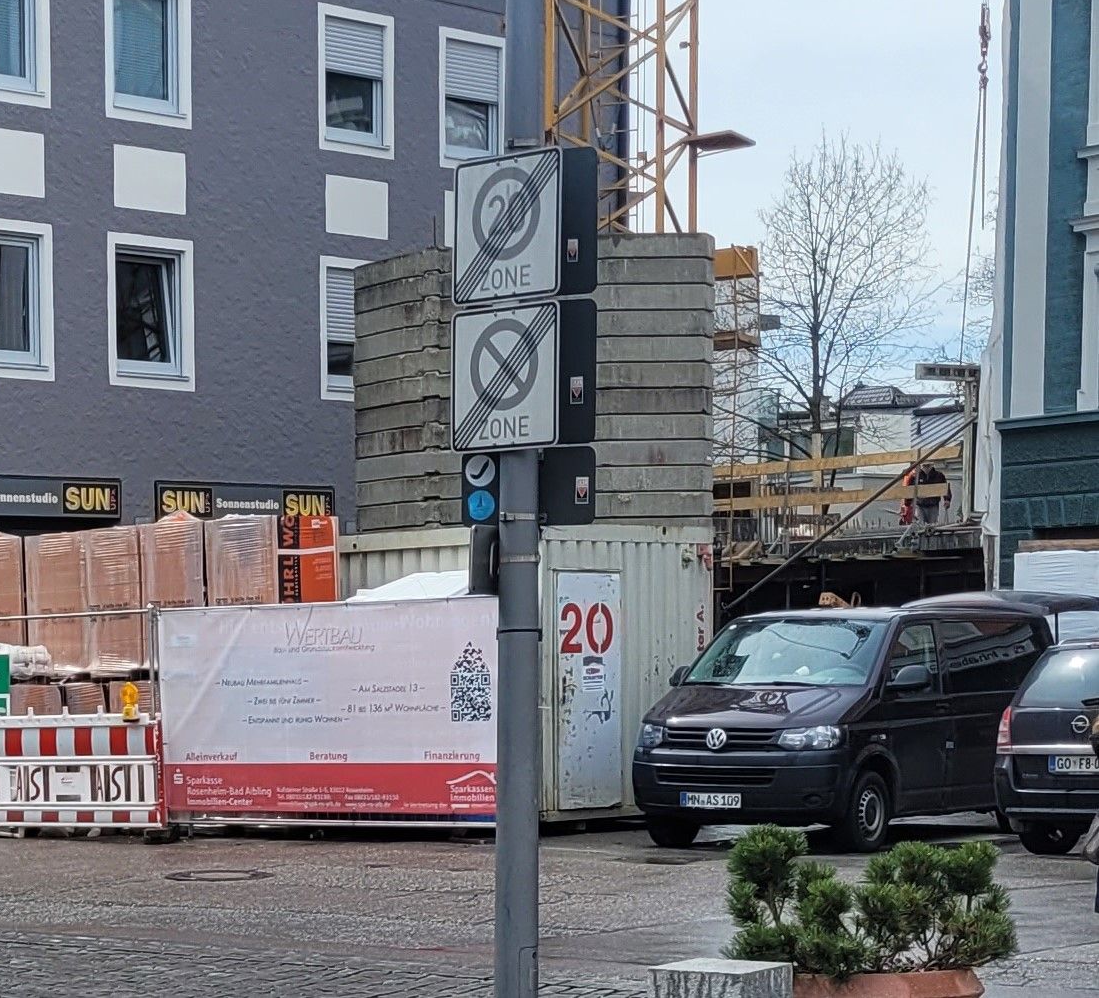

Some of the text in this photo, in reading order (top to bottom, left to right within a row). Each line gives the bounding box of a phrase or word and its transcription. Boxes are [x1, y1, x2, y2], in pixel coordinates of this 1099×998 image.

[479, 264, 531, 292] ZONE
[479, 415, 530, 440] ZONE
[65, 486, 111, 511] SUN
[162, 489, 205, 514] SUN
[216, 498, 279, 510] Sonnenstudio
[285, 493, 325, 517] SUN
[560, 602, 614, 654] 20
[409, 683, 418, 692] 13
[347, 704, 356, 713] 81
[369, 704, 383, 714] 136
[185, 752, 238, 761] Alleinverkauf
[309, 751, 348, 762] Beratung
[424, 751, 481, 762] Finanzierung
[186, 776, 223, 785] Sparkasse
[186, 787, 272, 798] Rosenheim-Bad Aibling
[449, 785, 494, 794] Sparkassen
[186, 798, 254, 806] Immobilien-Center
[449, 794, 495, 802] Immobilien
[706, 794, 719, 806] AS
[720, 795, 740, 806] 109
